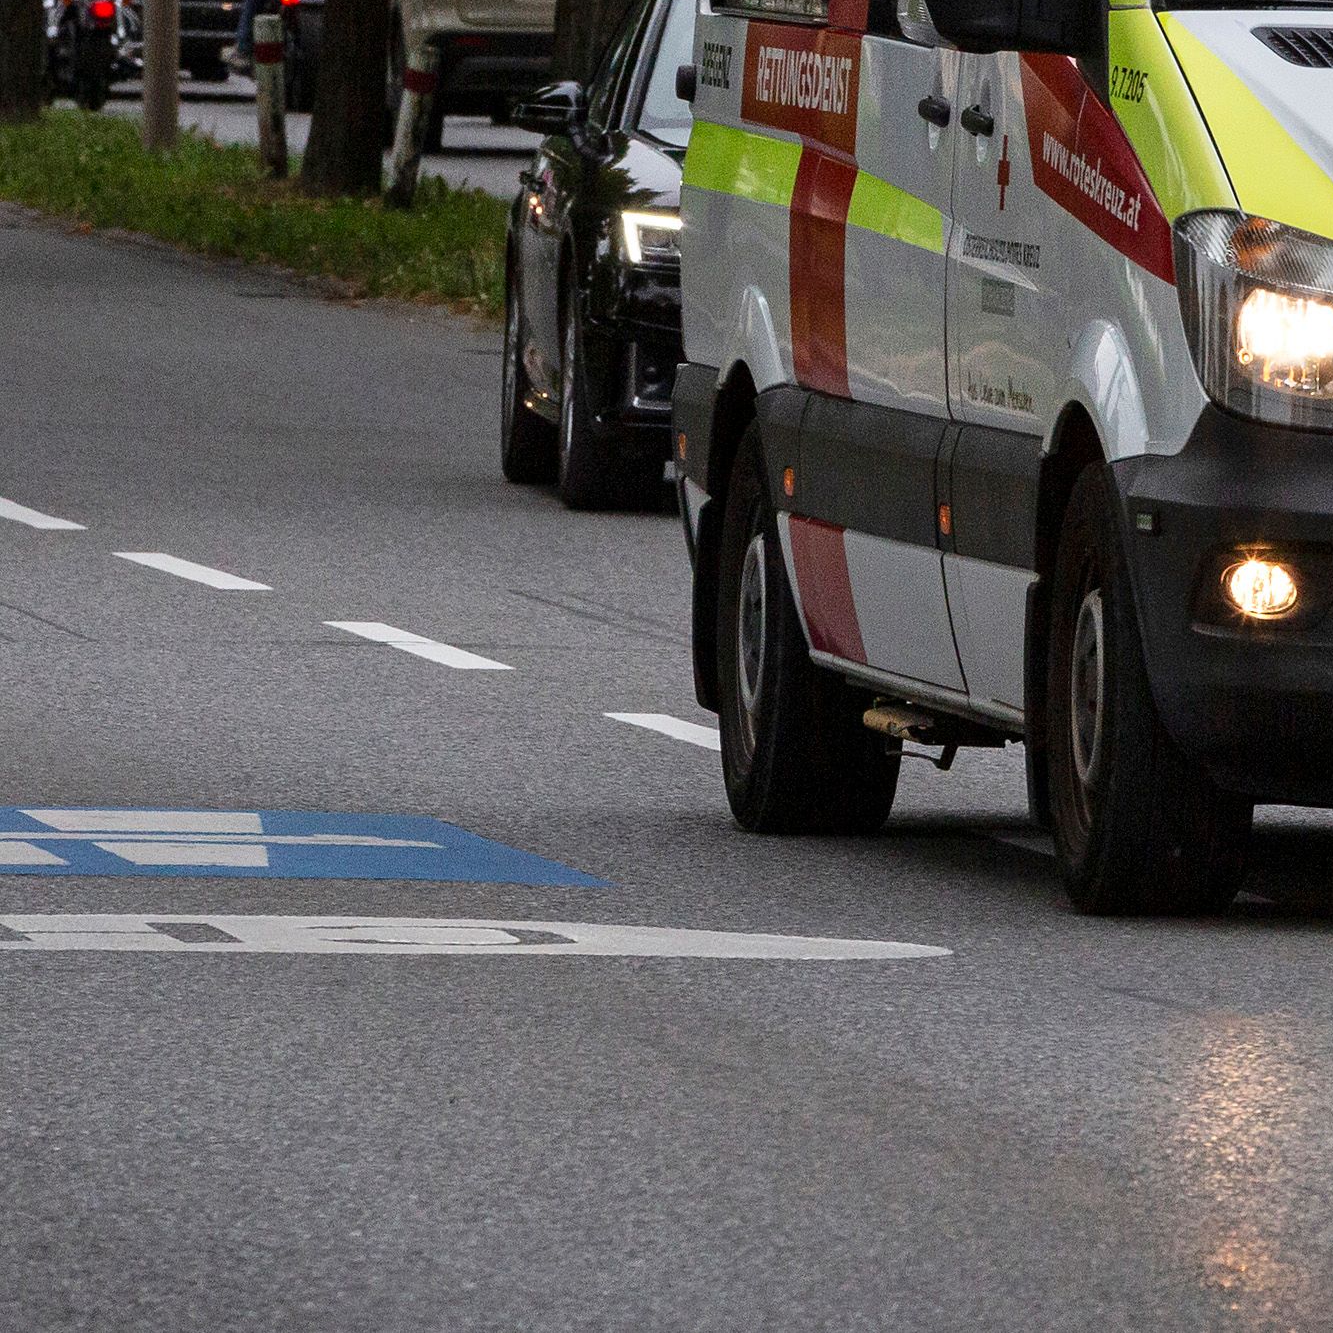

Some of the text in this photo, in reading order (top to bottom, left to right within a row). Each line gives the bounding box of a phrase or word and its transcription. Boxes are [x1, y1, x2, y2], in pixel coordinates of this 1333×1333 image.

[755, 45, 853, 115] RETTUNGSDIENST
[1110, 65, 1149, 103] 9.7.205
[1042, 130, 1142, 232] www.roteskreuz.at
